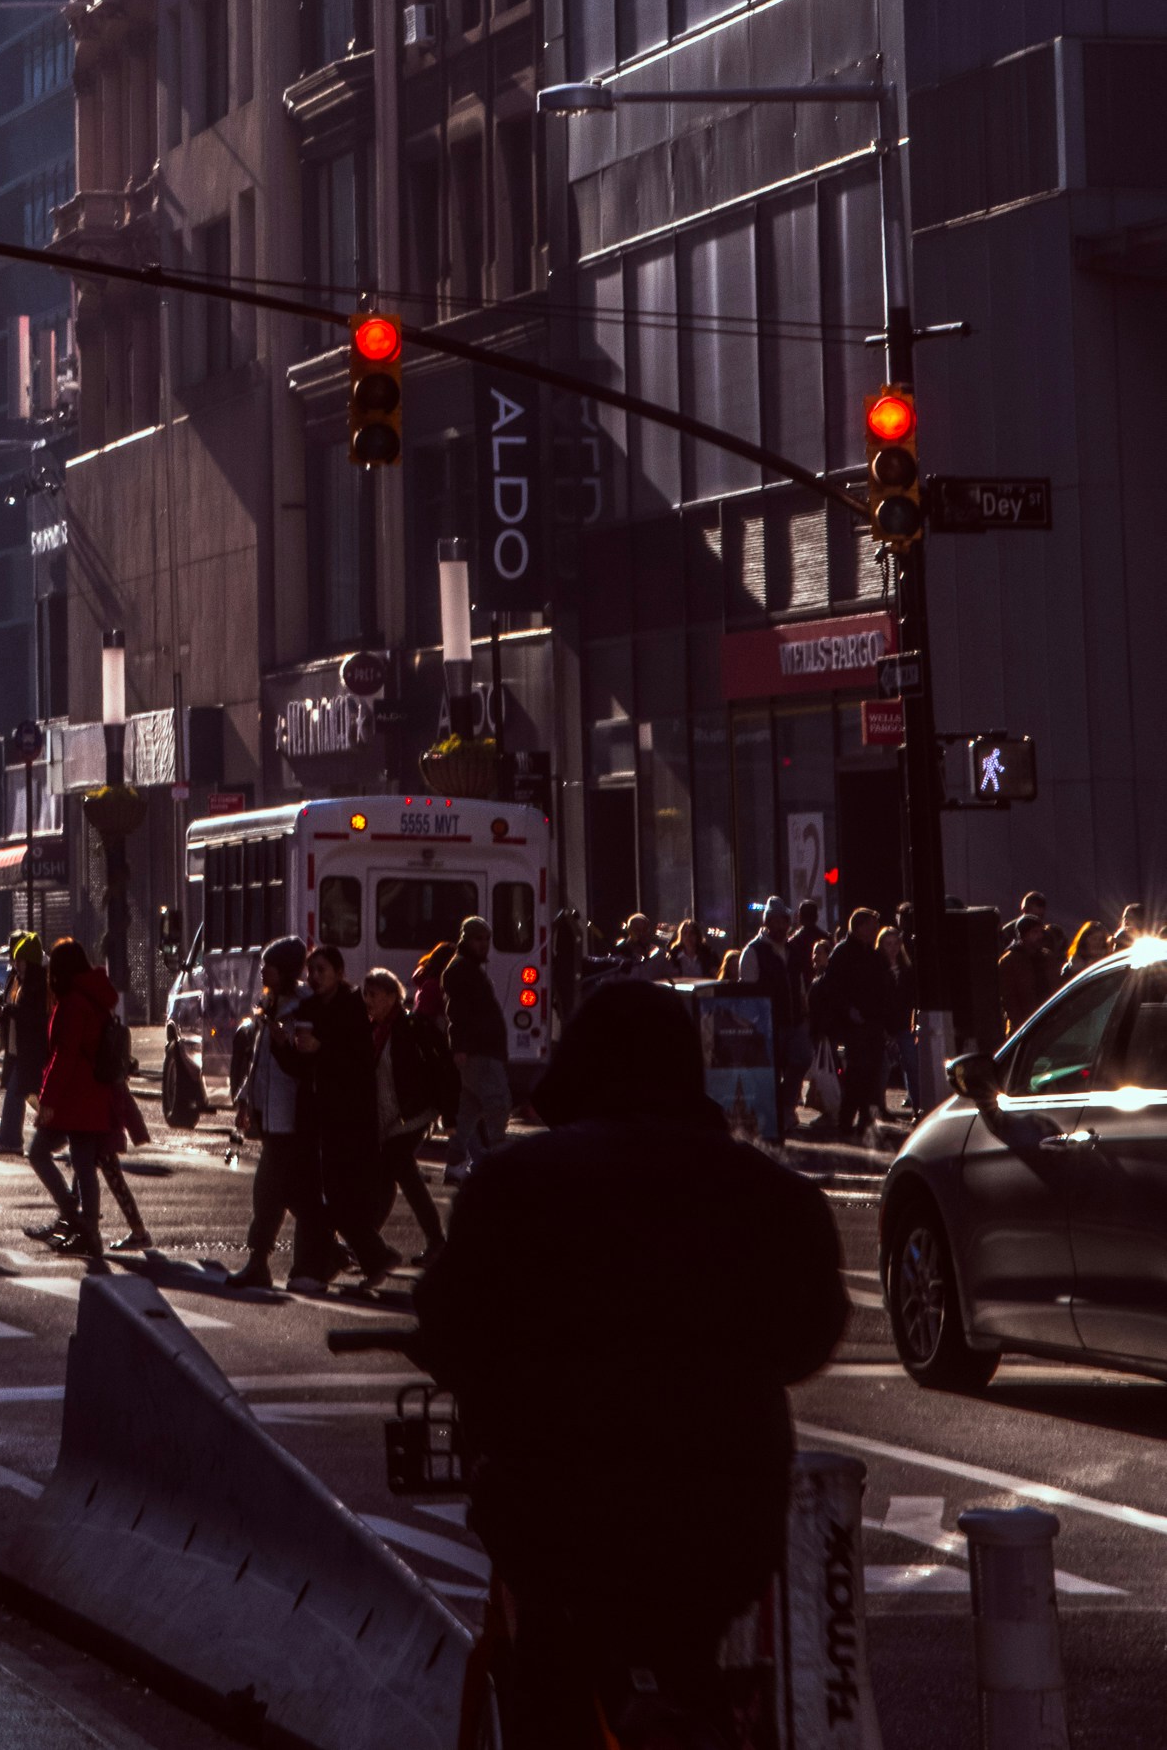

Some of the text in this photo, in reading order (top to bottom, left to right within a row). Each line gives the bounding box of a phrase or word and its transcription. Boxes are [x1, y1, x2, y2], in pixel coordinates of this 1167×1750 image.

[489, 385, 530, 581] ALDO
[982, 492, 1024, 523] Dey
[779, 630, 881, 675] WELLS FARGO
[868, 713, 903, 723] WELLS
[400, 813, 461, 835] 5555 MVT
